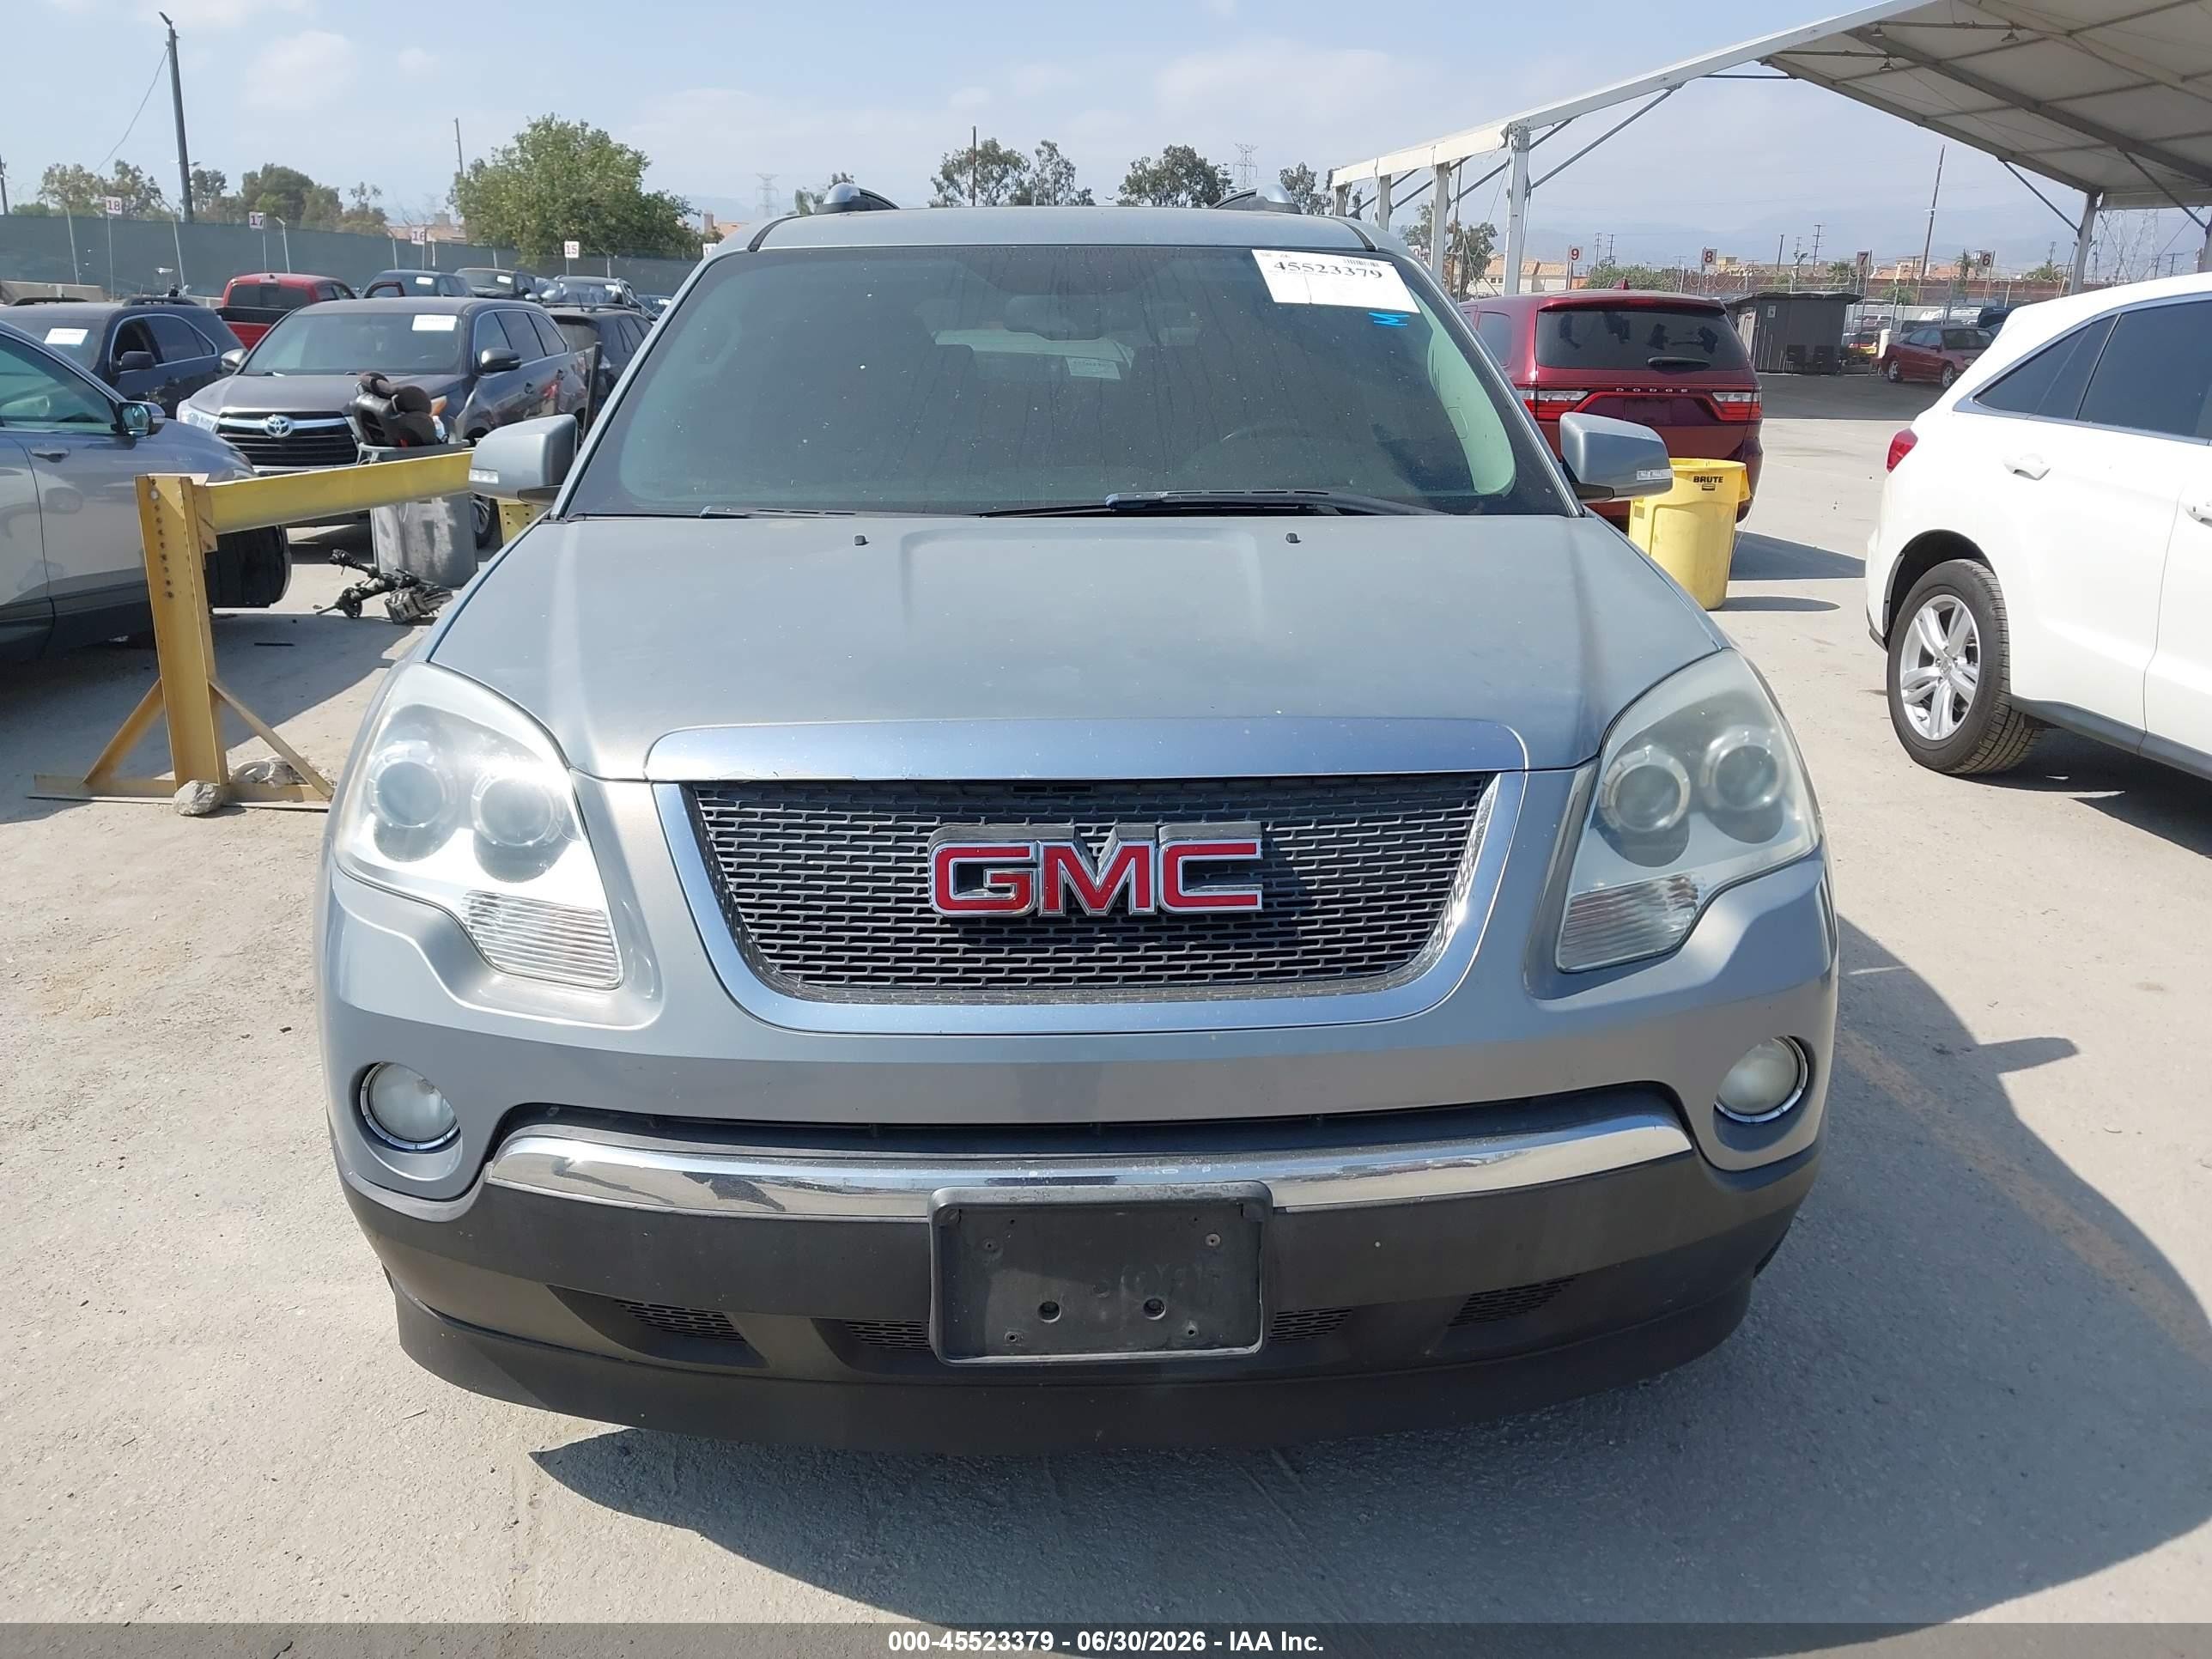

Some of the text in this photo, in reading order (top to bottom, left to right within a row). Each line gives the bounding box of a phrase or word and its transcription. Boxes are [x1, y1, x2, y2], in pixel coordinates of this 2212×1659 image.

[109, 198, 121, 210] 18
[251, 216, 264, 227] 17
[412, 230, 424, 241] 16
[566, 244, 578, 255] 15
[1571, 248, 1579, 261] 9
[1705, 252, 1713, 264] 8
[1860, 253, 1869, 265] 7
[1983, 253, 1991, 266] 6
[1274, 261, 1382, 279] 45523379
[928, 822, 1264, 917] GMC
